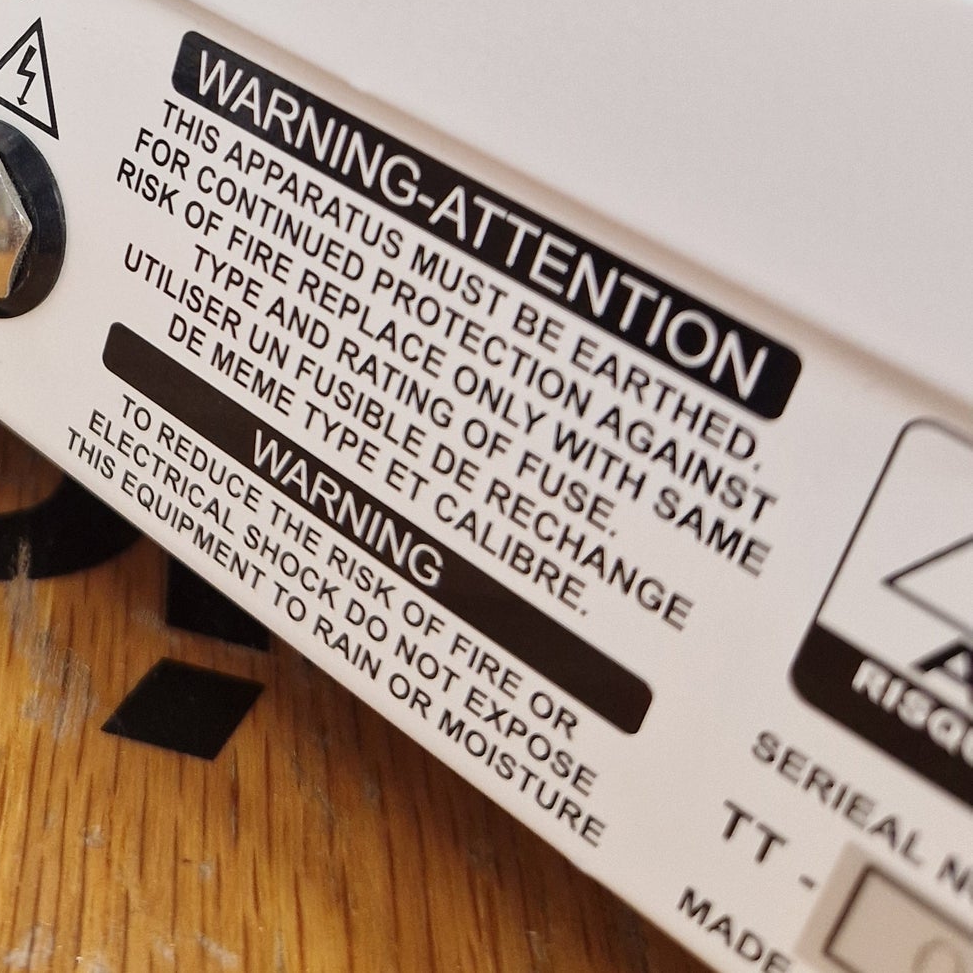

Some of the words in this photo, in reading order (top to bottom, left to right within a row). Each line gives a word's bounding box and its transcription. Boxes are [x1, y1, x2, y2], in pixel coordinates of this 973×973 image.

[116, 156, 181, 216] RISK
[184, 200, 224, 237] OF
[226, 224, 294, 285] FIRE
[297, 268, 447, 379] REPLACE
[453, 365, 548, 436] ONLY
[553, 421, 647, 502] WITH
[653, 486, 772, 578] SAME
[134, 126, 191, 182] FOR
[196, 165, 365, 282] CONTINUED
[371, 267, 593, 419] PROTECTION
[595, 405, 778, 523] AGAINST
[162, 98, 221, 155] THIS
[223, 140, 404, 260] APPARATUS
[409, 243, 509, 317] MUST
[512, 301, 566, 354] BE
[570, 335, 761, 472] EARTHED.
[194, 243, 264, 310] TYPE
[265, 296, 330, 350] AND
[336, 336, 454, 429] RATING
[463, 418, 513, 459] OF
[516, 450, 617, 538] FUSE.
[198, 50, 767, 399] WARNING-ATTENTION
[88, 408, 235, 536] ELECTRICAL
[243, 523, 341, 610] SHOCK
[344, 597, 388, 643] DO
[394, 634, 461, 693] NOT
[463, 685, 598, 798] EXPOSE
[122, 393, 152, 432] TO
[156, 421, 263, 513] REDUCE
[270, 499, 323, 556] THE
[326, 544, 397, 610] RISK
[402, 600, 446, 637] OF
[449, 632, 523, 700] FIRE
[529, 691, 578, 741] OR
[124, 242, 242, 340] UTILISER
[248, 323, 291, 370] UN
[294, 354, 427, 459] FUSIBLE
[430, 442, 480, 494] DE
[484, 477, 694, 632] RECHANGE
[167, 312, 207, 358] DE
[210, 341, 296, 417] MEME
[304, 400, 381, 473] TYPE
[384, 457, 430, 502] ET
[434, 493, 588, 617] CALIBRE.
[253, 429, 444, 587] WARNING
[67, 426, 116, 480] THIS
[120, 469, 267, 590] EQUIPMENT
[273, 580, 307, 622] TO
[312, 614, 382, 681] RAIN
[388, 672, 432, 720] OR
[437, 708, 606, 849] MOISTURE
[751, 730, 924, 869] SERIEAL
[677, 887, 793, 973] MADE
[722, 799, 787, 864] TT
